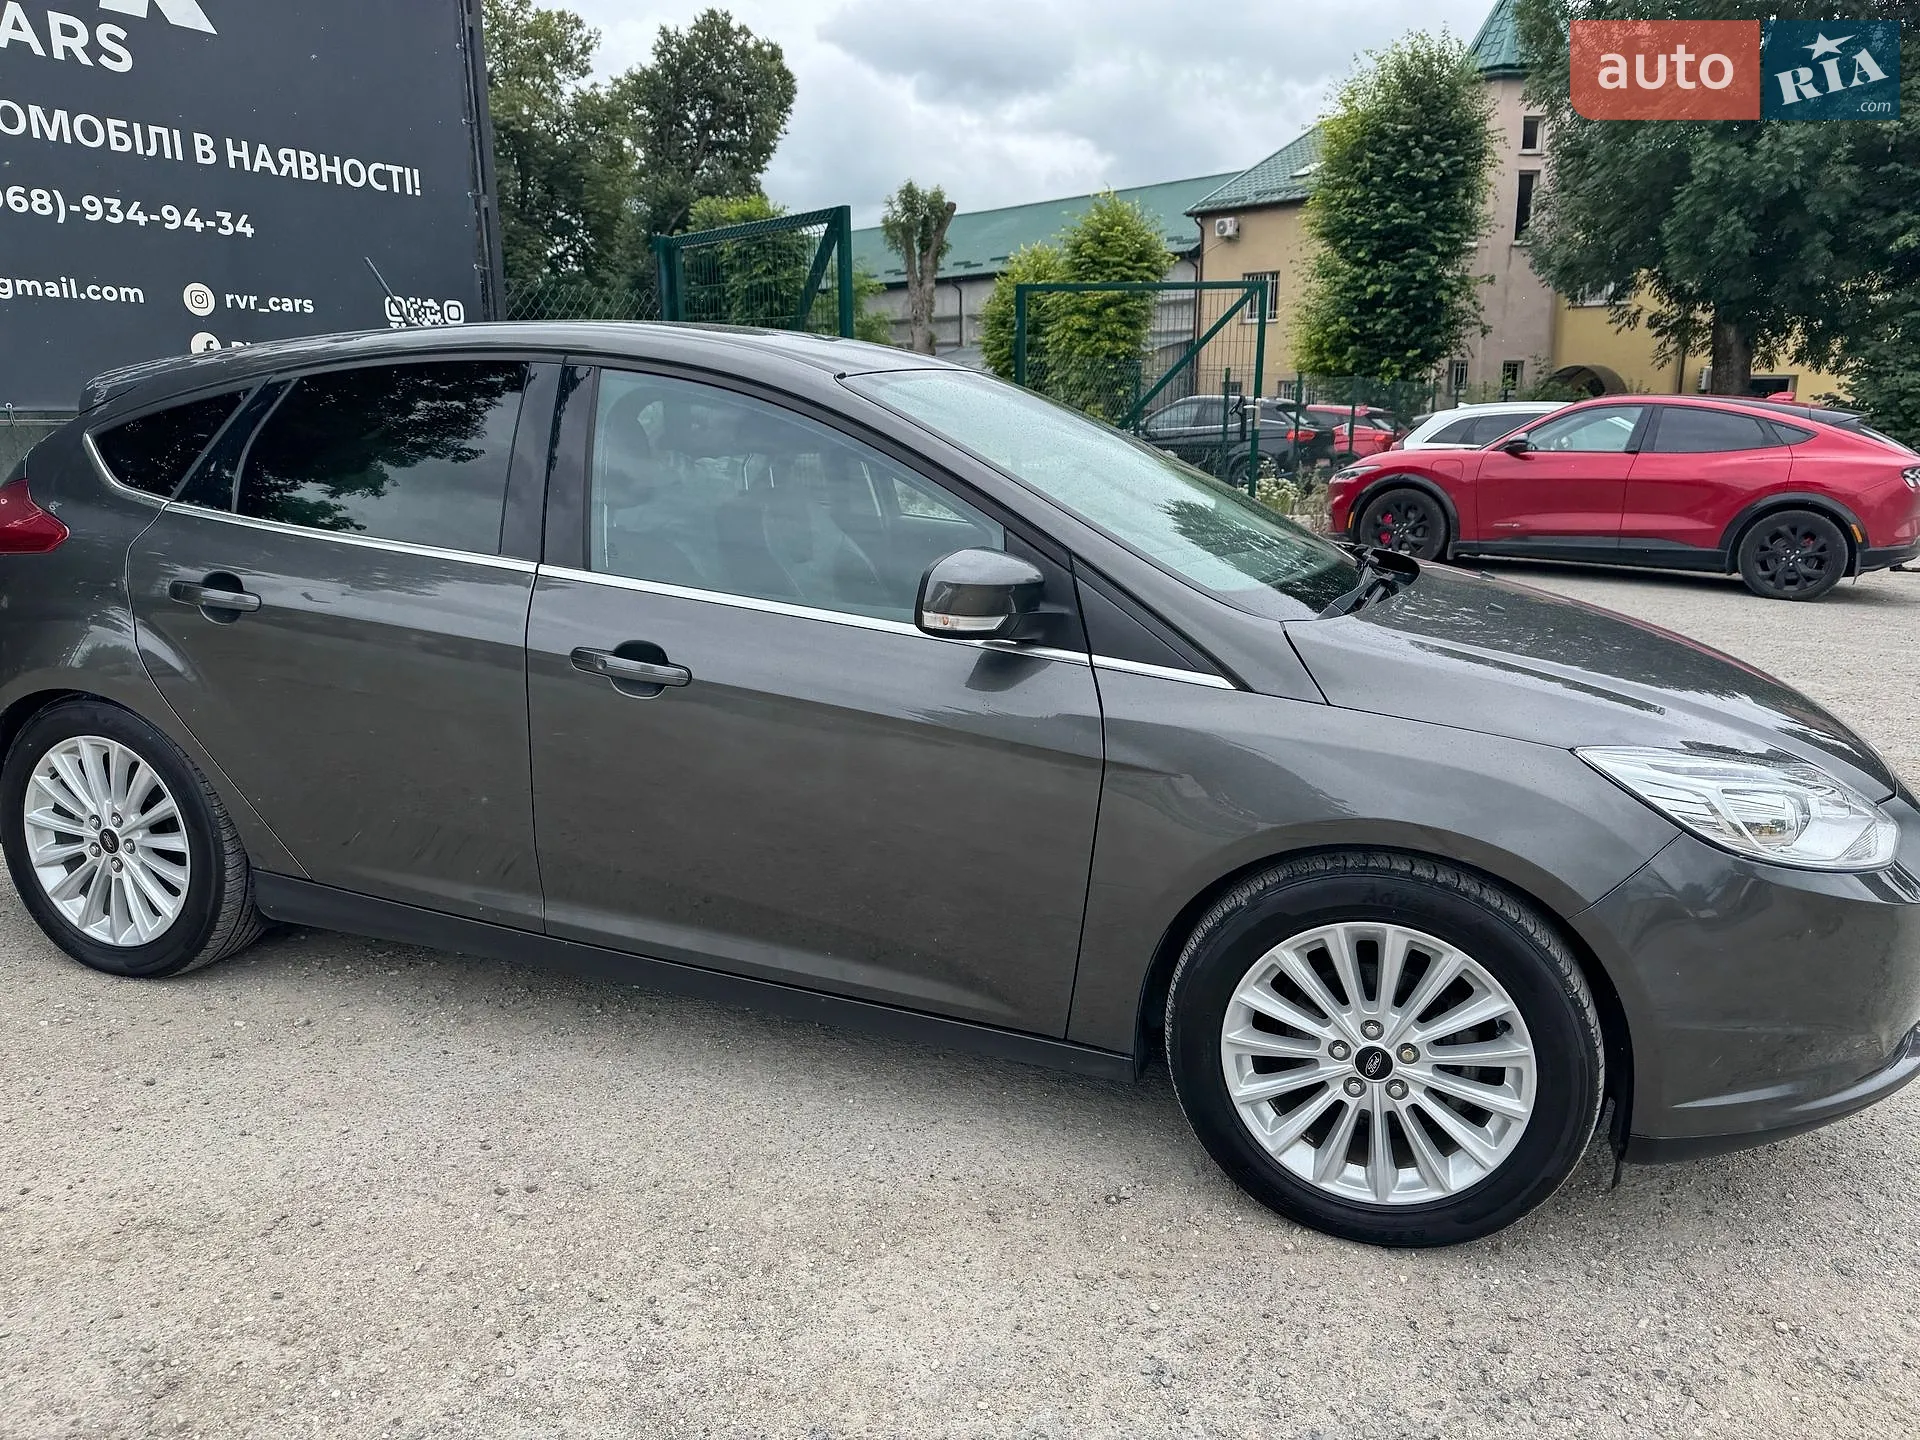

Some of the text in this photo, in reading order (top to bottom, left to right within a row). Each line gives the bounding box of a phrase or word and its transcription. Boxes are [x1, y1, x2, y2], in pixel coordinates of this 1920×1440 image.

[194, 133, 216, 164] В
[226, 138, 420, 196] НАЯВНОСТІ!
[0, 186, 254, 237] 68)-934-94-34
[226, 294, 314, 313] rvr_cars
